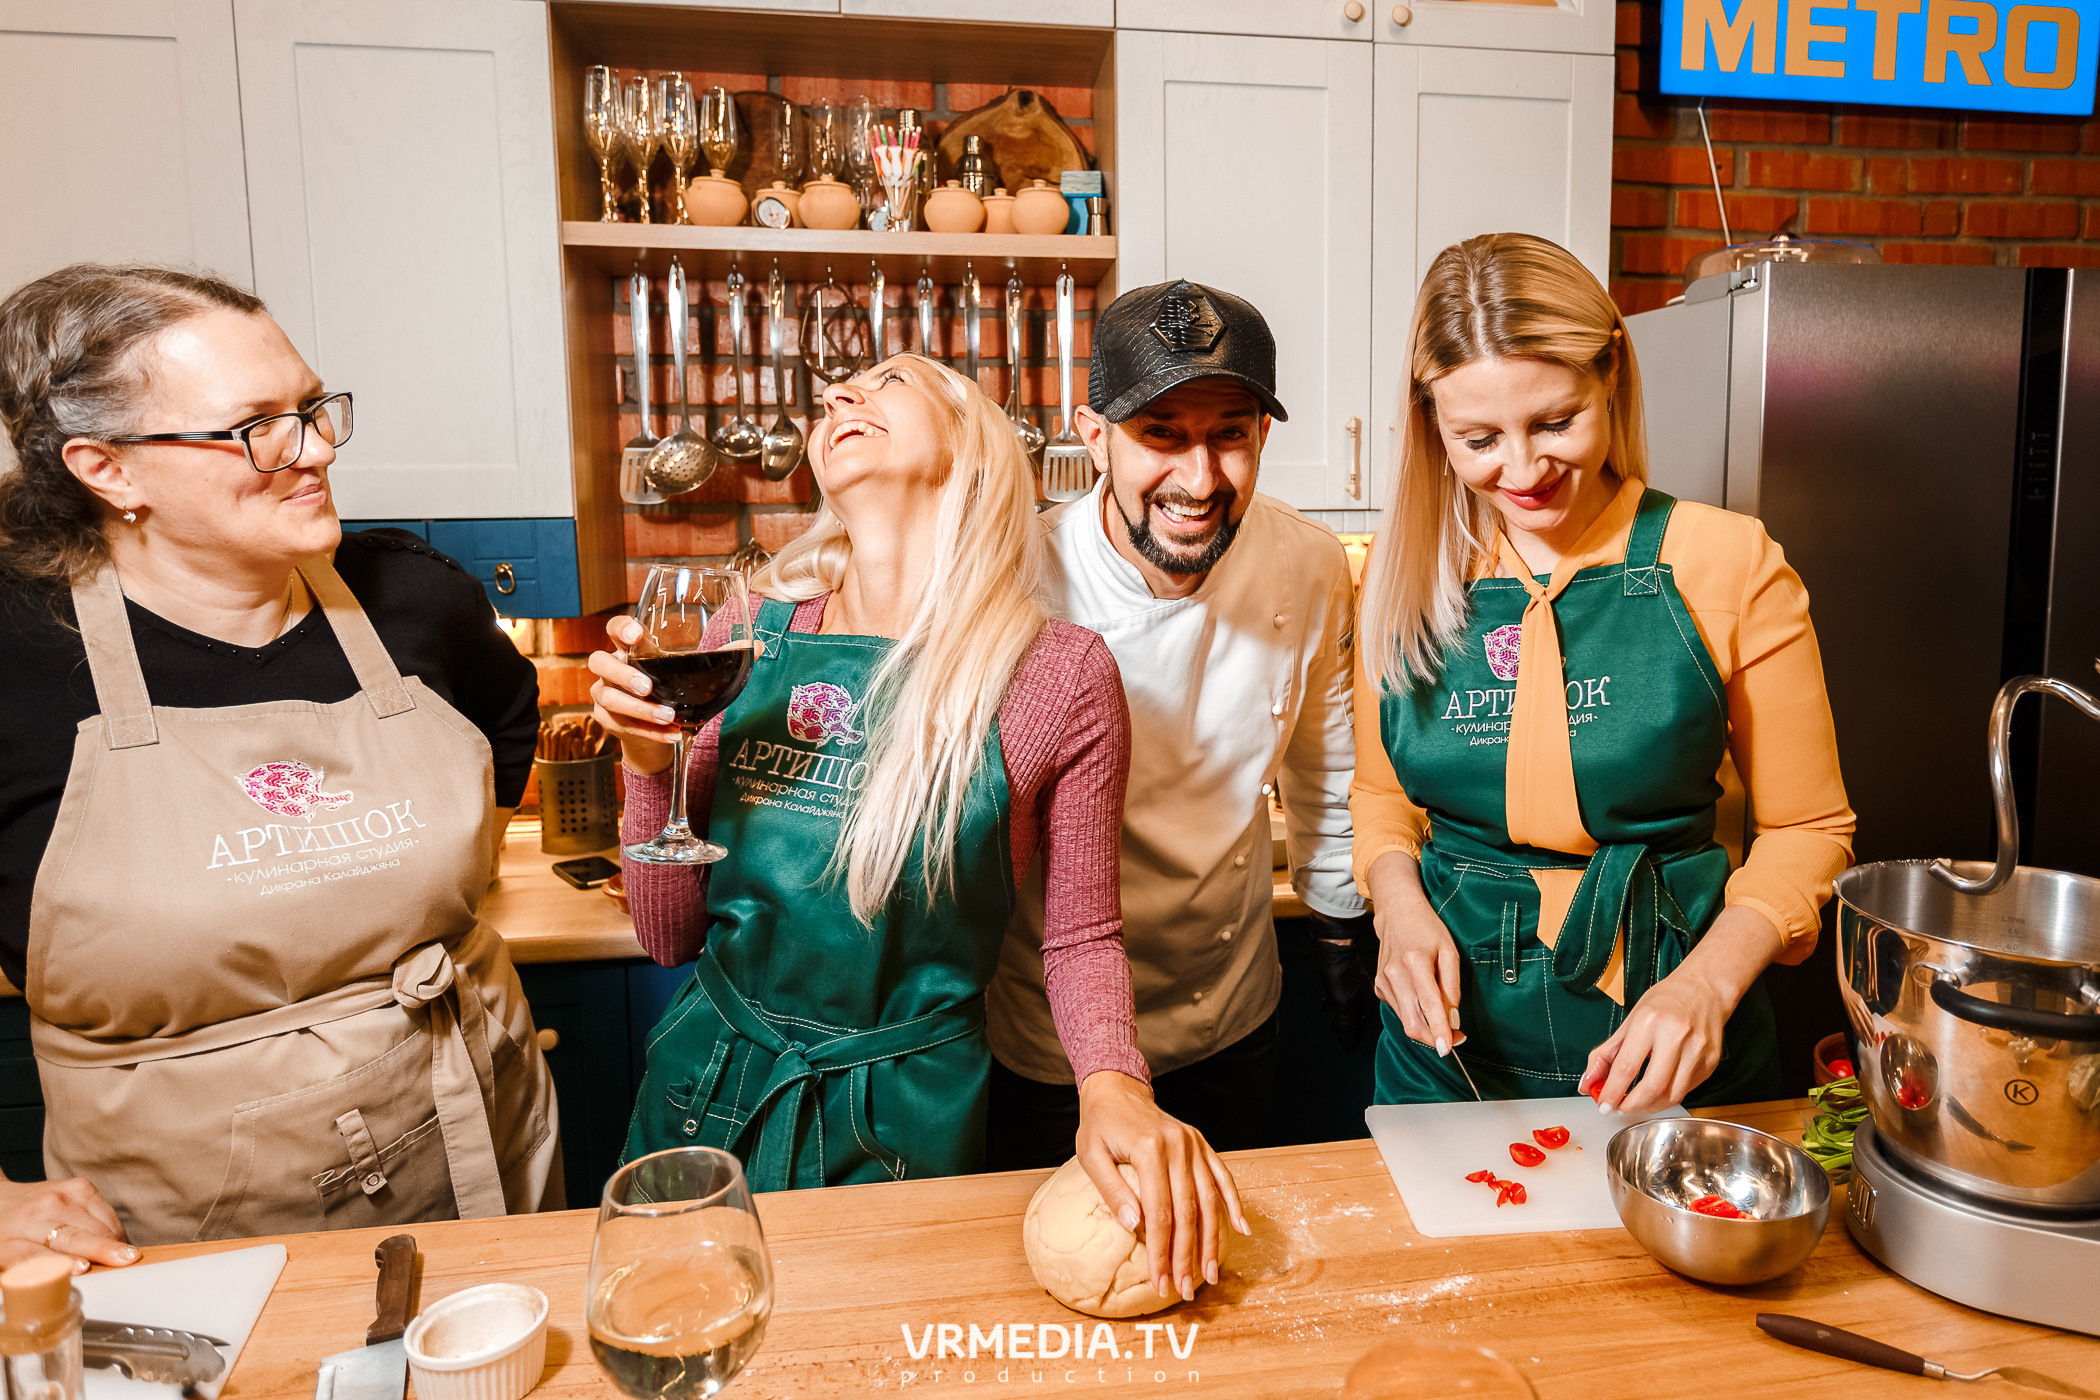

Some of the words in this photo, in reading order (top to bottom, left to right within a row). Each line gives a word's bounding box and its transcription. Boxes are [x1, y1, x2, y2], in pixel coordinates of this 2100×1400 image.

[1681, 0, 2081, 90] METRO
[729, 738, 869, 791] АРТИШО
[739, 791, 783, 808] Дикрана
[206, 799, 427, 870] АРТИШОК
[260, 876, 321, 896] Дикрана
[323, 858, 401, 882] Калайджяна
[2013, 1083, 2031, 1102] K
